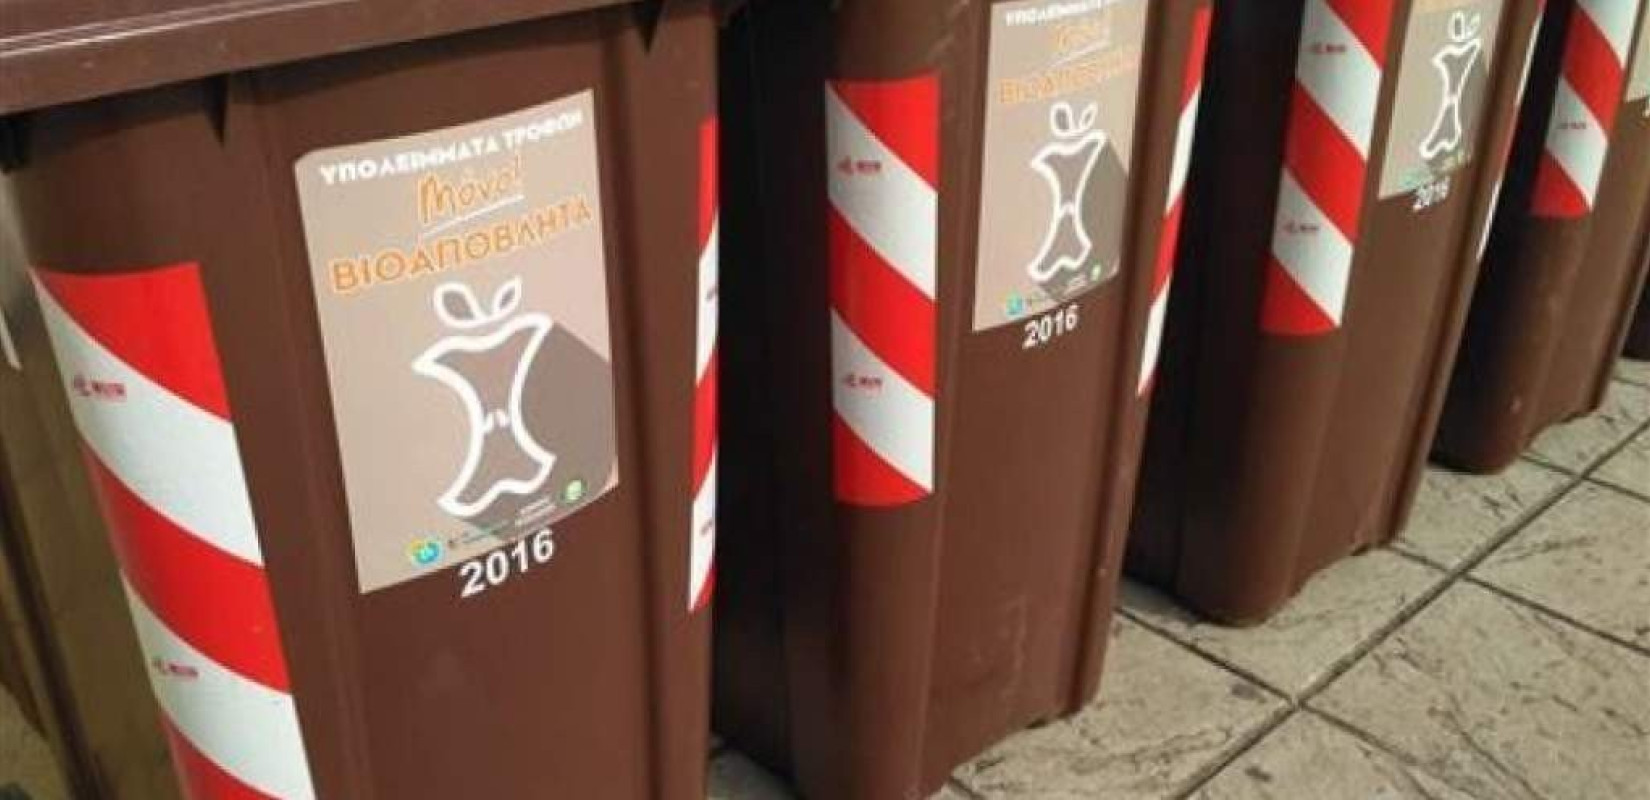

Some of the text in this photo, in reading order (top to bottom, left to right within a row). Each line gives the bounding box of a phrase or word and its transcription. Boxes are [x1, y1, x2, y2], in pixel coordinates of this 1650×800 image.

[320, 138, 499, 185] ΥΠΟΛΕΙΜΜΑΤΑ
[331, 195, 593, 292] ΒΙΟΑΠΟΒΛΗΤΑ
[1022, 303, 1079, 349] 2016
[460, 529, 554, 598] 2016
